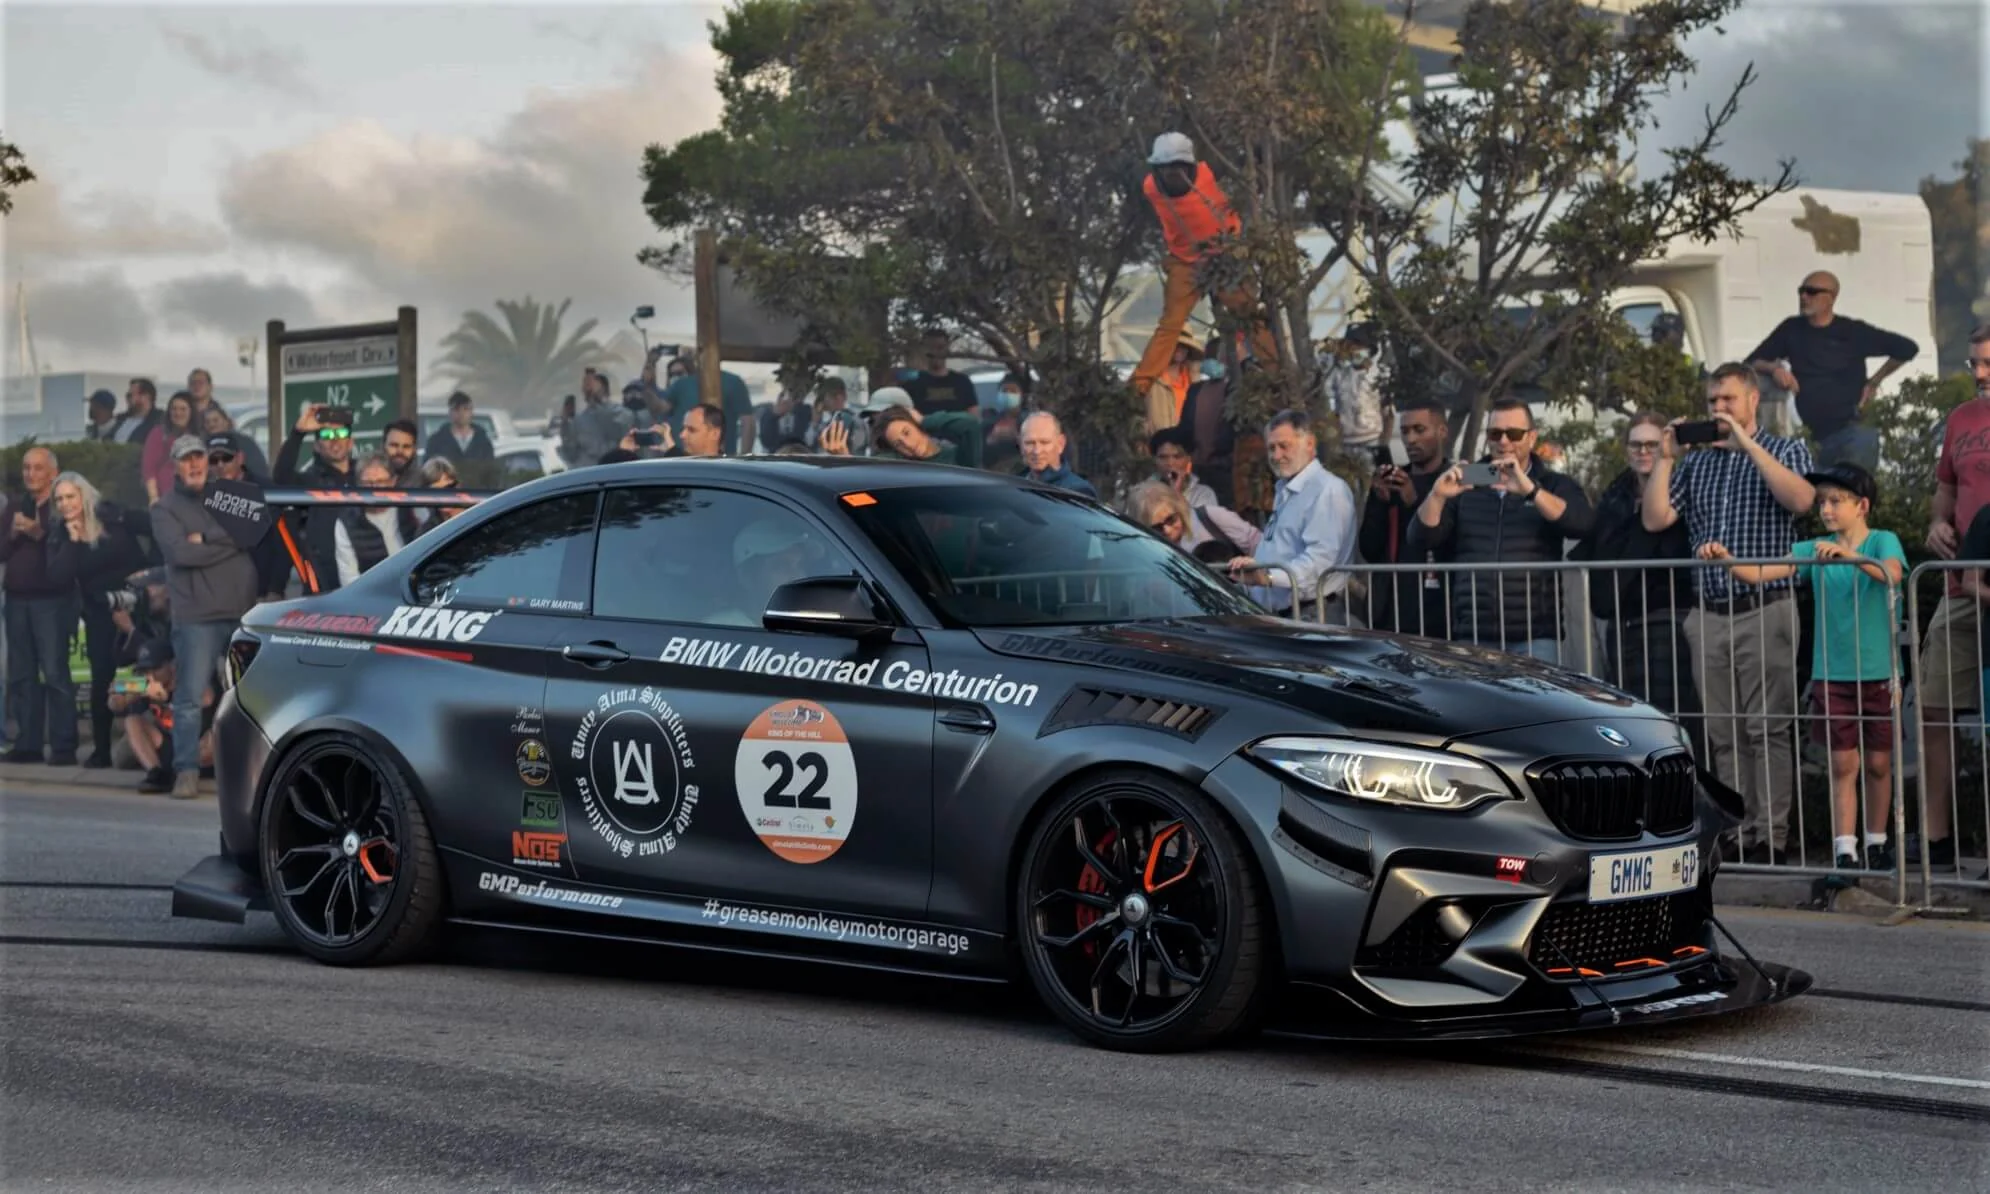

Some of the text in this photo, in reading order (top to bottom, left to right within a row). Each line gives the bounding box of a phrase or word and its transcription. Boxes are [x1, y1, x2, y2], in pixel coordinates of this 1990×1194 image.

[296, 350, 357, 369] Waterfront
[327, 384, 350, 406] N2
[204, 498, 261, 521] PROJECTS
[530, 598, 584, 610] GARY MARTINS
[378, 606, 493, 642] KING
[659, 636, 1039, 707] BMW Motorrad Centurion
[571, 710, 596, 760] Unity
[597, 688, 637, 713] Alma
[761, 750, 831, 810] 22
[512, 831, 567, 861] NOS
[1499, 857, 1526, 871] TOW
[1610, 849, 1697, 895] GMMG GP
[479, 872, 623, 910] GMPerformance
[701, 897, 970, 954] #greasemonkeymotorgarage
